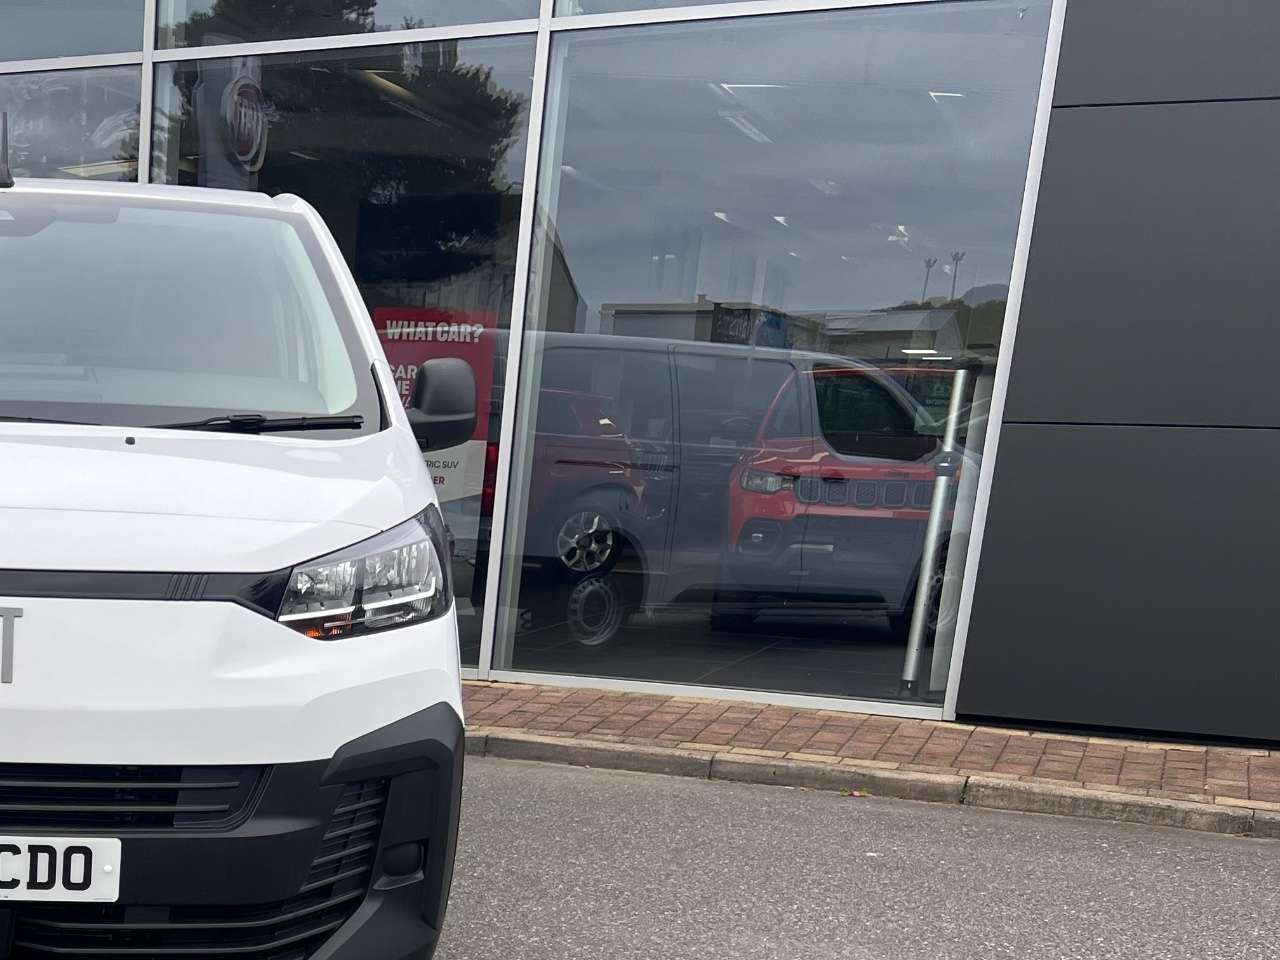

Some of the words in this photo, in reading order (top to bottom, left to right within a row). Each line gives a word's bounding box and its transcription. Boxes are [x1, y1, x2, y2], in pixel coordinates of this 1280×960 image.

[386, 319, 436, 341] WHAT
[436, 321, 484, 343] CAR?
[442, 460, 459, 469] SUV
